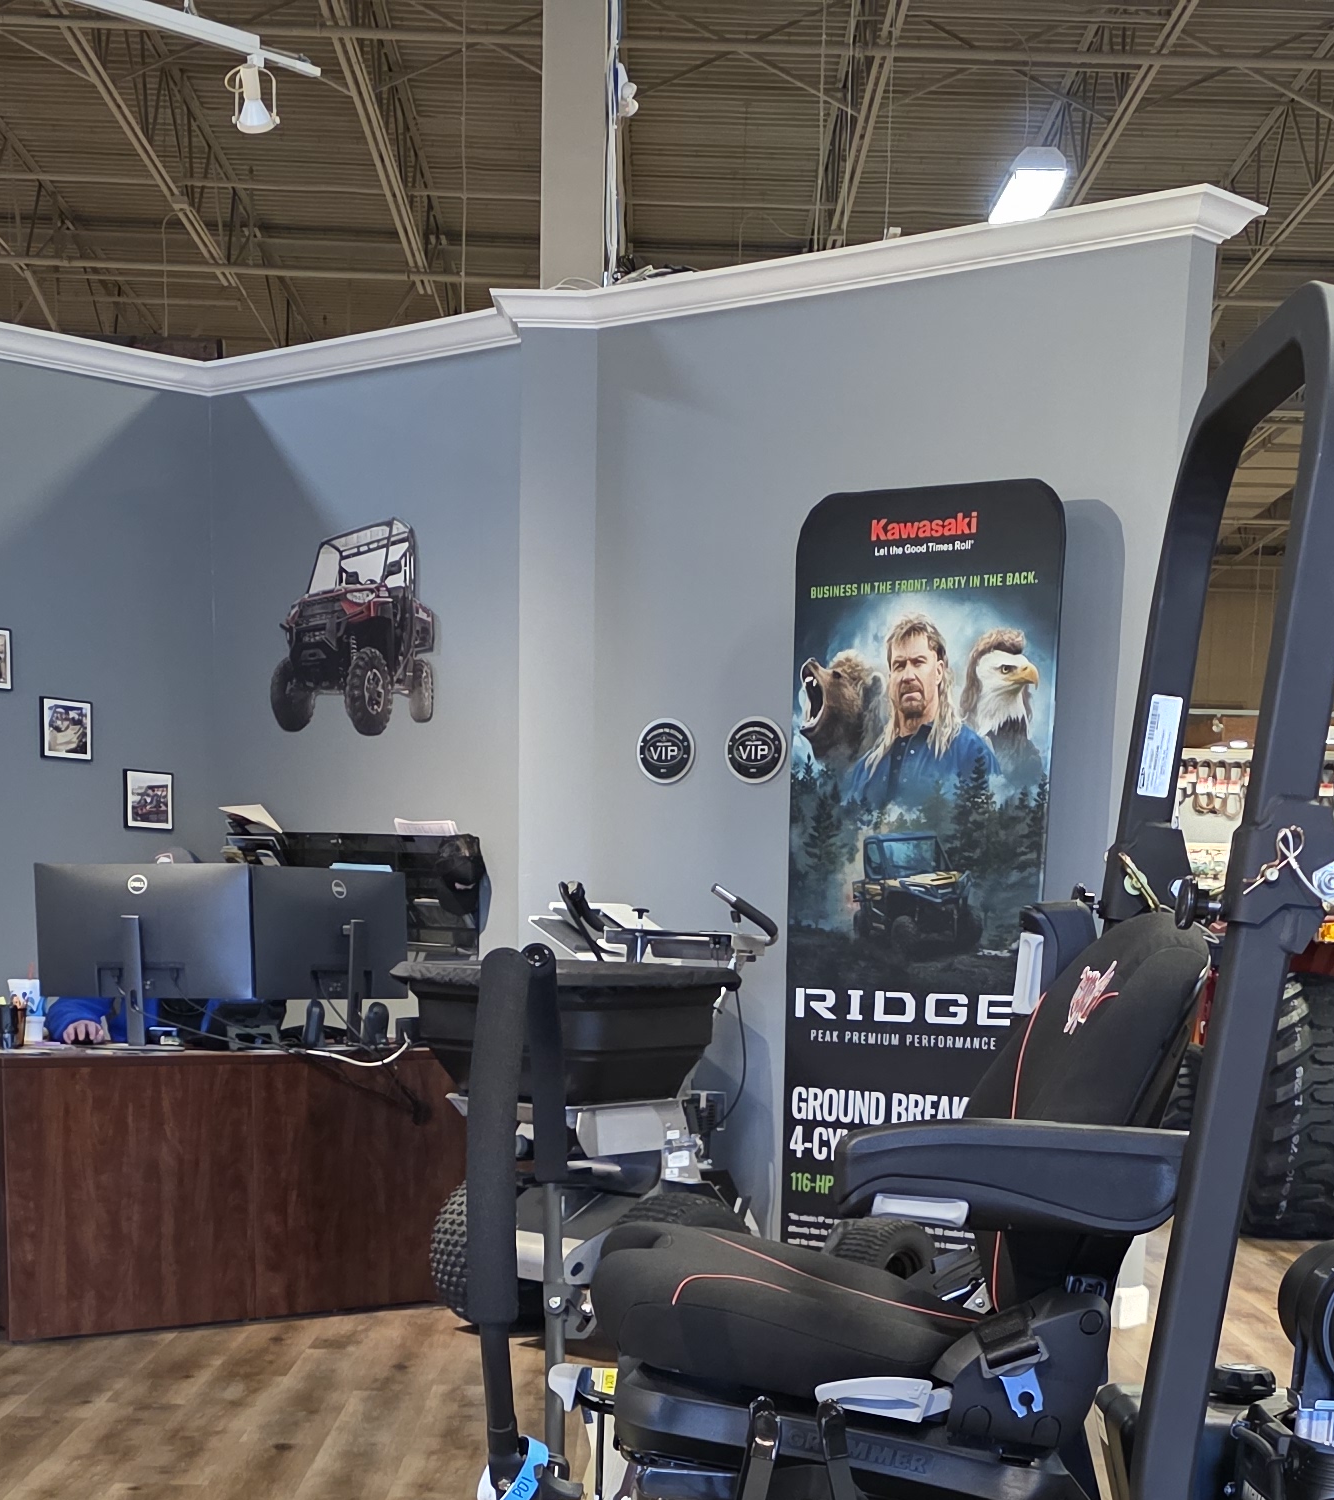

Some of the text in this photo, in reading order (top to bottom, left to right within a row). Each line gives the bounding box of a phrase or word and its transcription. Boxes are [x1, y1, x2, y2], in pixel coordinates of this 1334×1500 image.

[870, 511, 978, 541] Kawasaki
[874, 545, 888, 556] Let
[889, 544, 903, 555] the
[904, 543, 927, 554] Good
[927, 541, 953, 552] Times
[810, 571, 1038, 599] BUSINESS IN THE FRONT. PARTY IN THE BACK.
[650, 746, 678, 760] VIP
[739, 745, 768, 760] VIP
[794, 987, 1014, 1027] RIDGE
[810, 1029, 997, 1050] PEAK PREMIUM PERFORMANCE
[791, 1086, 886, 1126] GROUND
[790, 1171, 834, 1195] 116-HP
[788, 1428, 926, 1474] GRMMER
[512, 1476, 533, 1499] PDI
